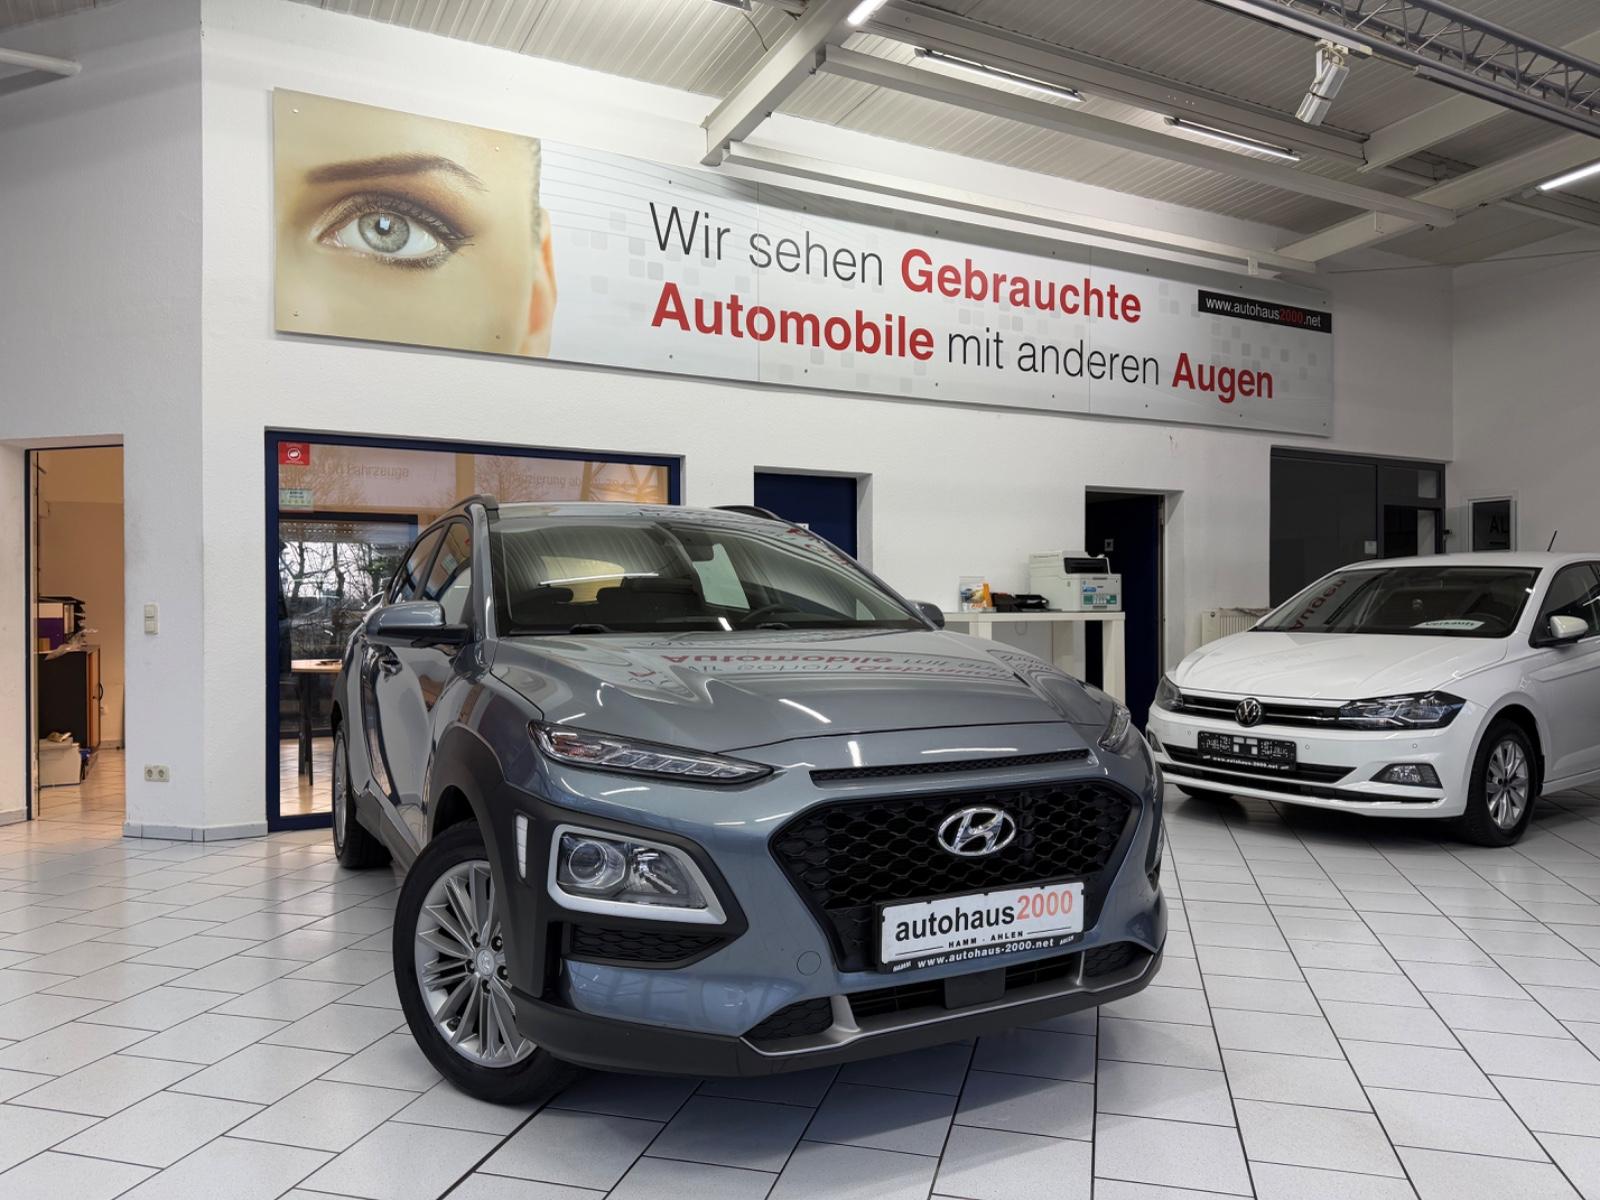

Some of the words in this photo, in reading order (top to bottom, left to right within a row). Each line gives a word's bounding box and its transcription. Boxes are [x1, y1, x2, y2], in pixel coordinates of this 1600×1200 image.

[649, 202, 731, 261] Wir
[748, 231, 883, 286] sehen
[901, 247, 1142, 323] Gebrauchte
[1205, 297, 1321, 328] www.autohaus2000.net
[651, 281, 935, 361] Automobile
[947, 326, 1004, 370] mit
[1017, 340, 1160, 386] anderen
[1172, 352, 1274, 404] Augen
[895, 889, 1073, 942] autohaus2000
[916, 937, 1055, 969] www.autohaus-2000.net
[948, 936, 977, 948] HAMM
[990, 930, 1024, 942] AHLEN
